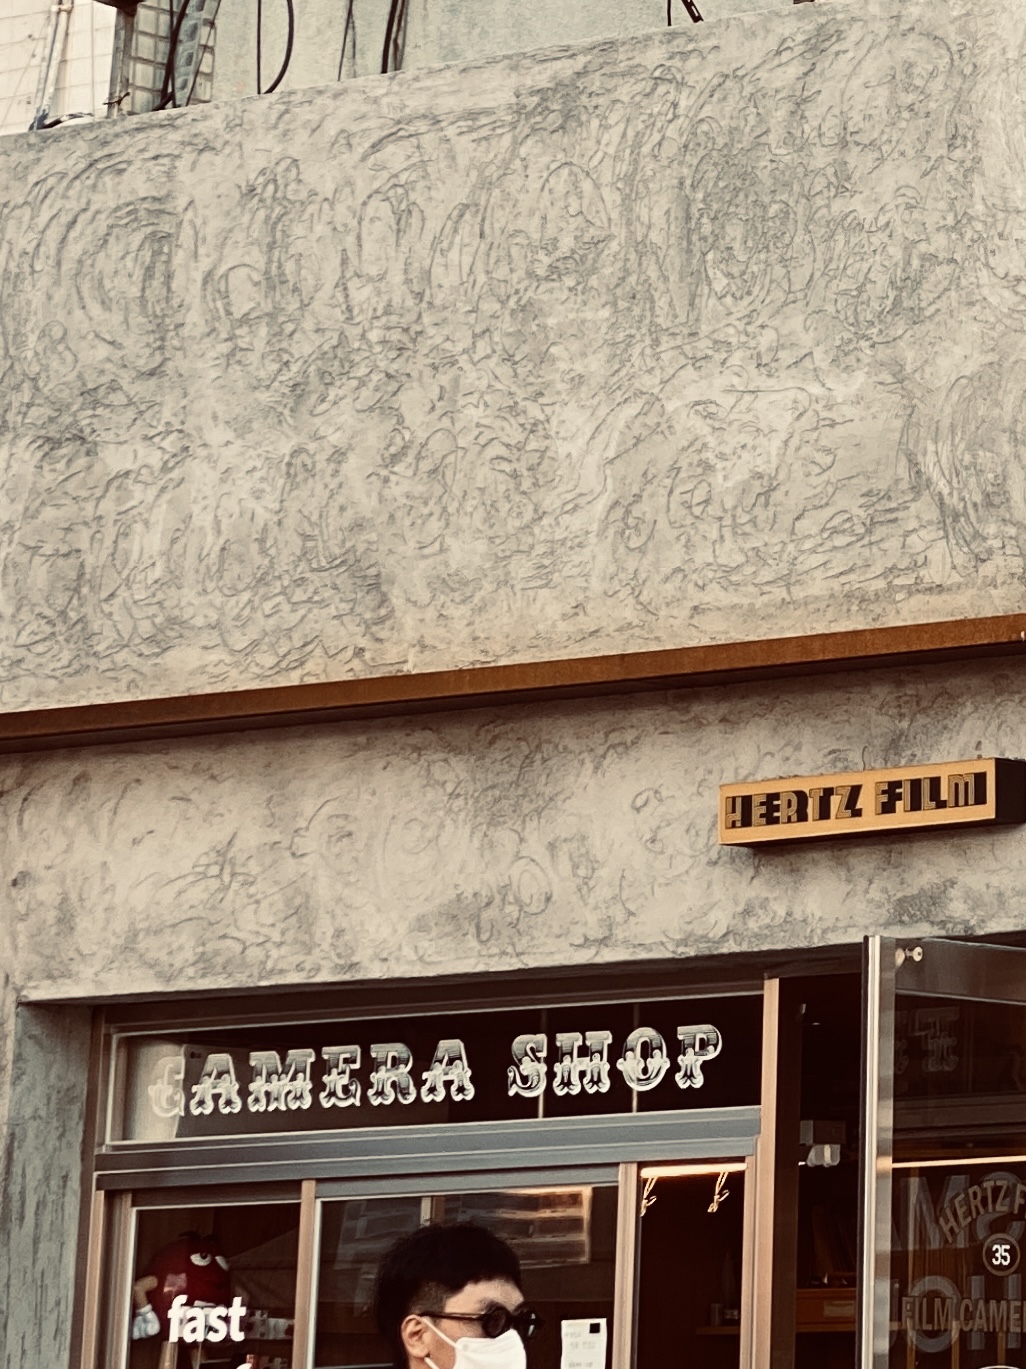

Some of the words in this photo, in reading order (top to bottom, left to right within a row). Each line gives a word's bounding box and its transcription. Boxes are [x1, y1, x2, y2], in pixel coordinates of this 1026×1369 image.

[725, 784, 864, 829] HERTZ
[874, 771, 988, 816] FILM
[148, 1039, 475, 1118] CAMERA
[507, 1024, 723, 1099] SHOP
[940, 1180, 1011, 1244] HERTZ
[991, 1244, 1011, 1266] 35
[167, 1294, 247, 1343] fast
[902, 1297, 952, 1331] FILM
